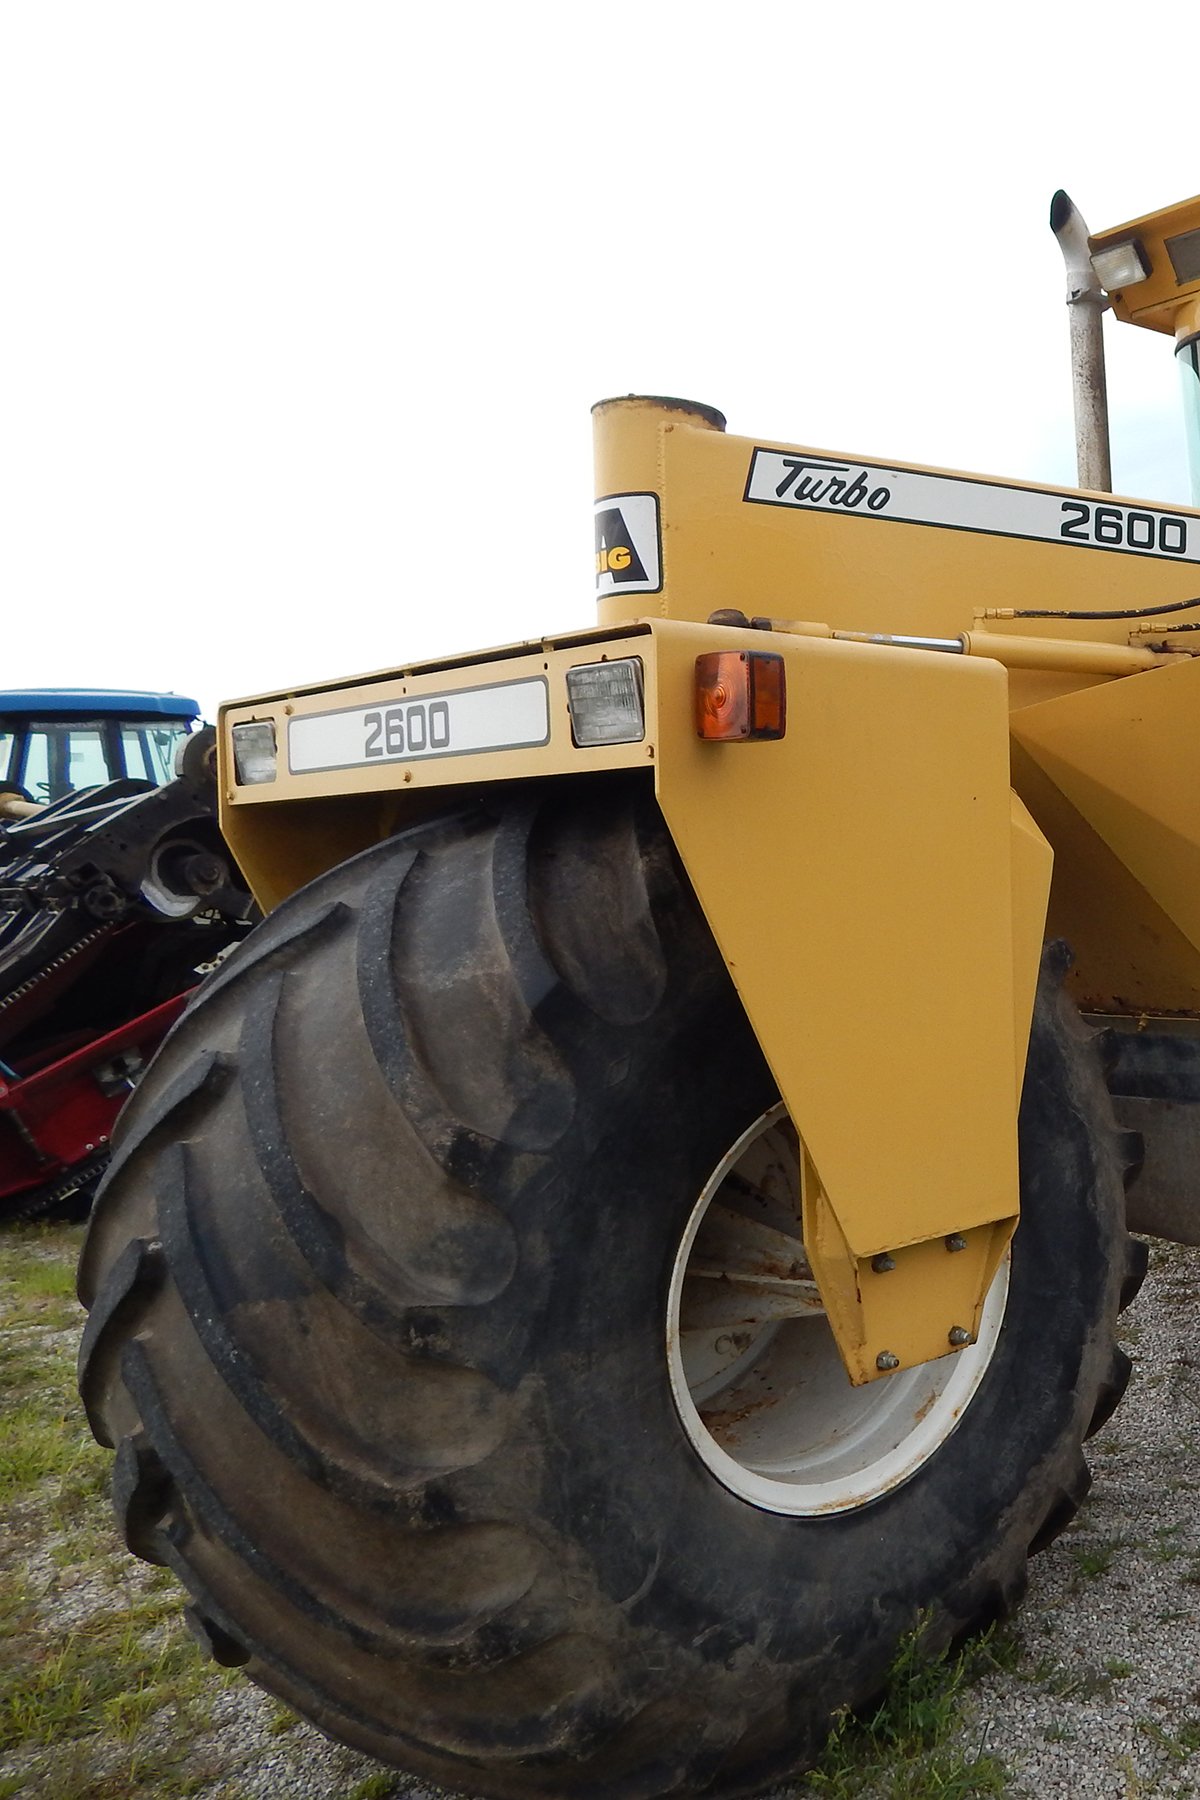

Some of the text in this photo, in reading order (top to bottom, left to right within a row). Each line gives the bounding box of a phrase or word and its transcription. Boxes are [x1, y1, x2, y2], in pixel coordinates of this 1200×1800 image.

[776, 458, 1187, 554] Turbo 2600
[596, 546, 632, 574] IG
[363, 700, 450, 758] 2600
